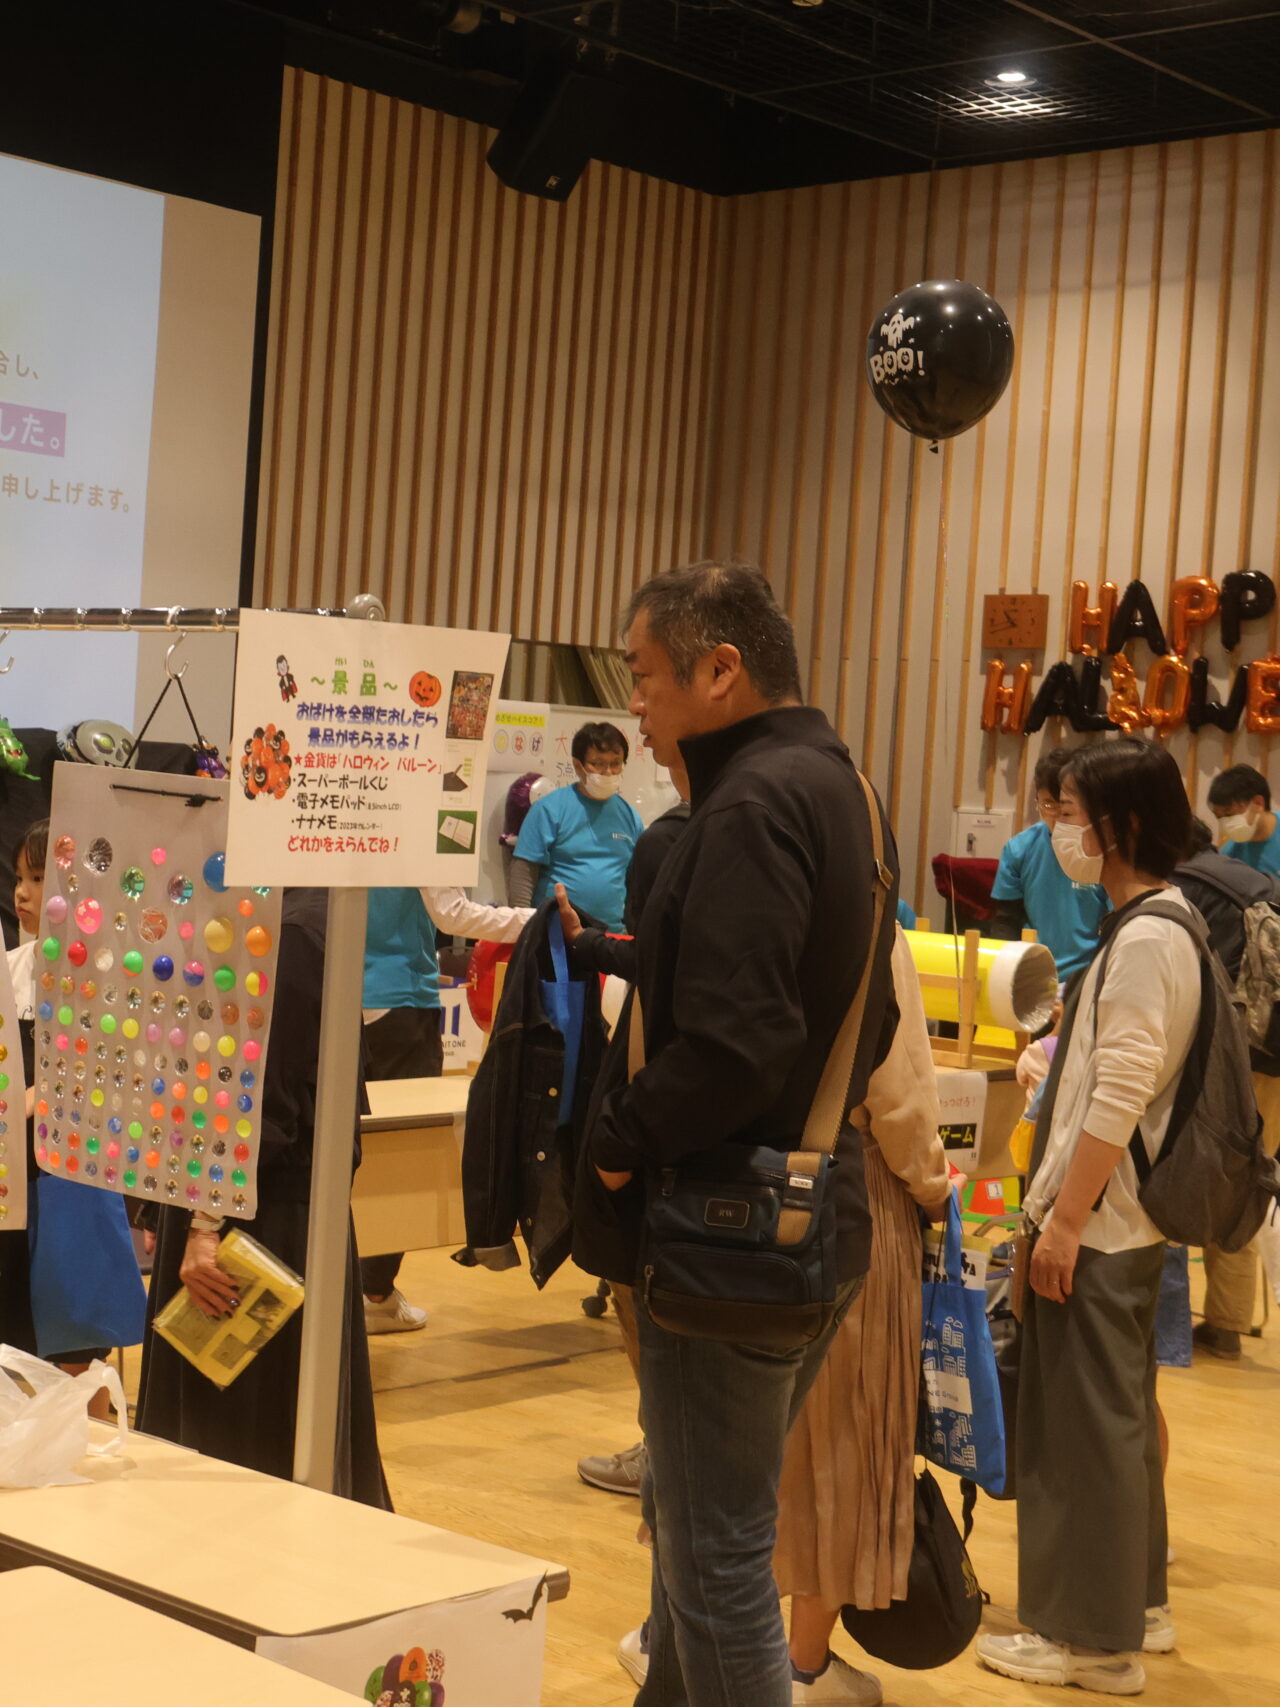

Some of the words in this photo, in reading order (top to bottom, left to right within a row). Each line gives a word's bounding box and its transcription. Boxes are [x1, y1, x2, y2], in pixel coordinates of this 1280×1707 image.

[869, 347, 926, 385] BOO!
[296, 702, 440, 728] おばけを全部たおしたら
[307, 727, 420, 750] 景品がもらえるよ！
[287, 835, 400, 854] どれかをえらんでね！
